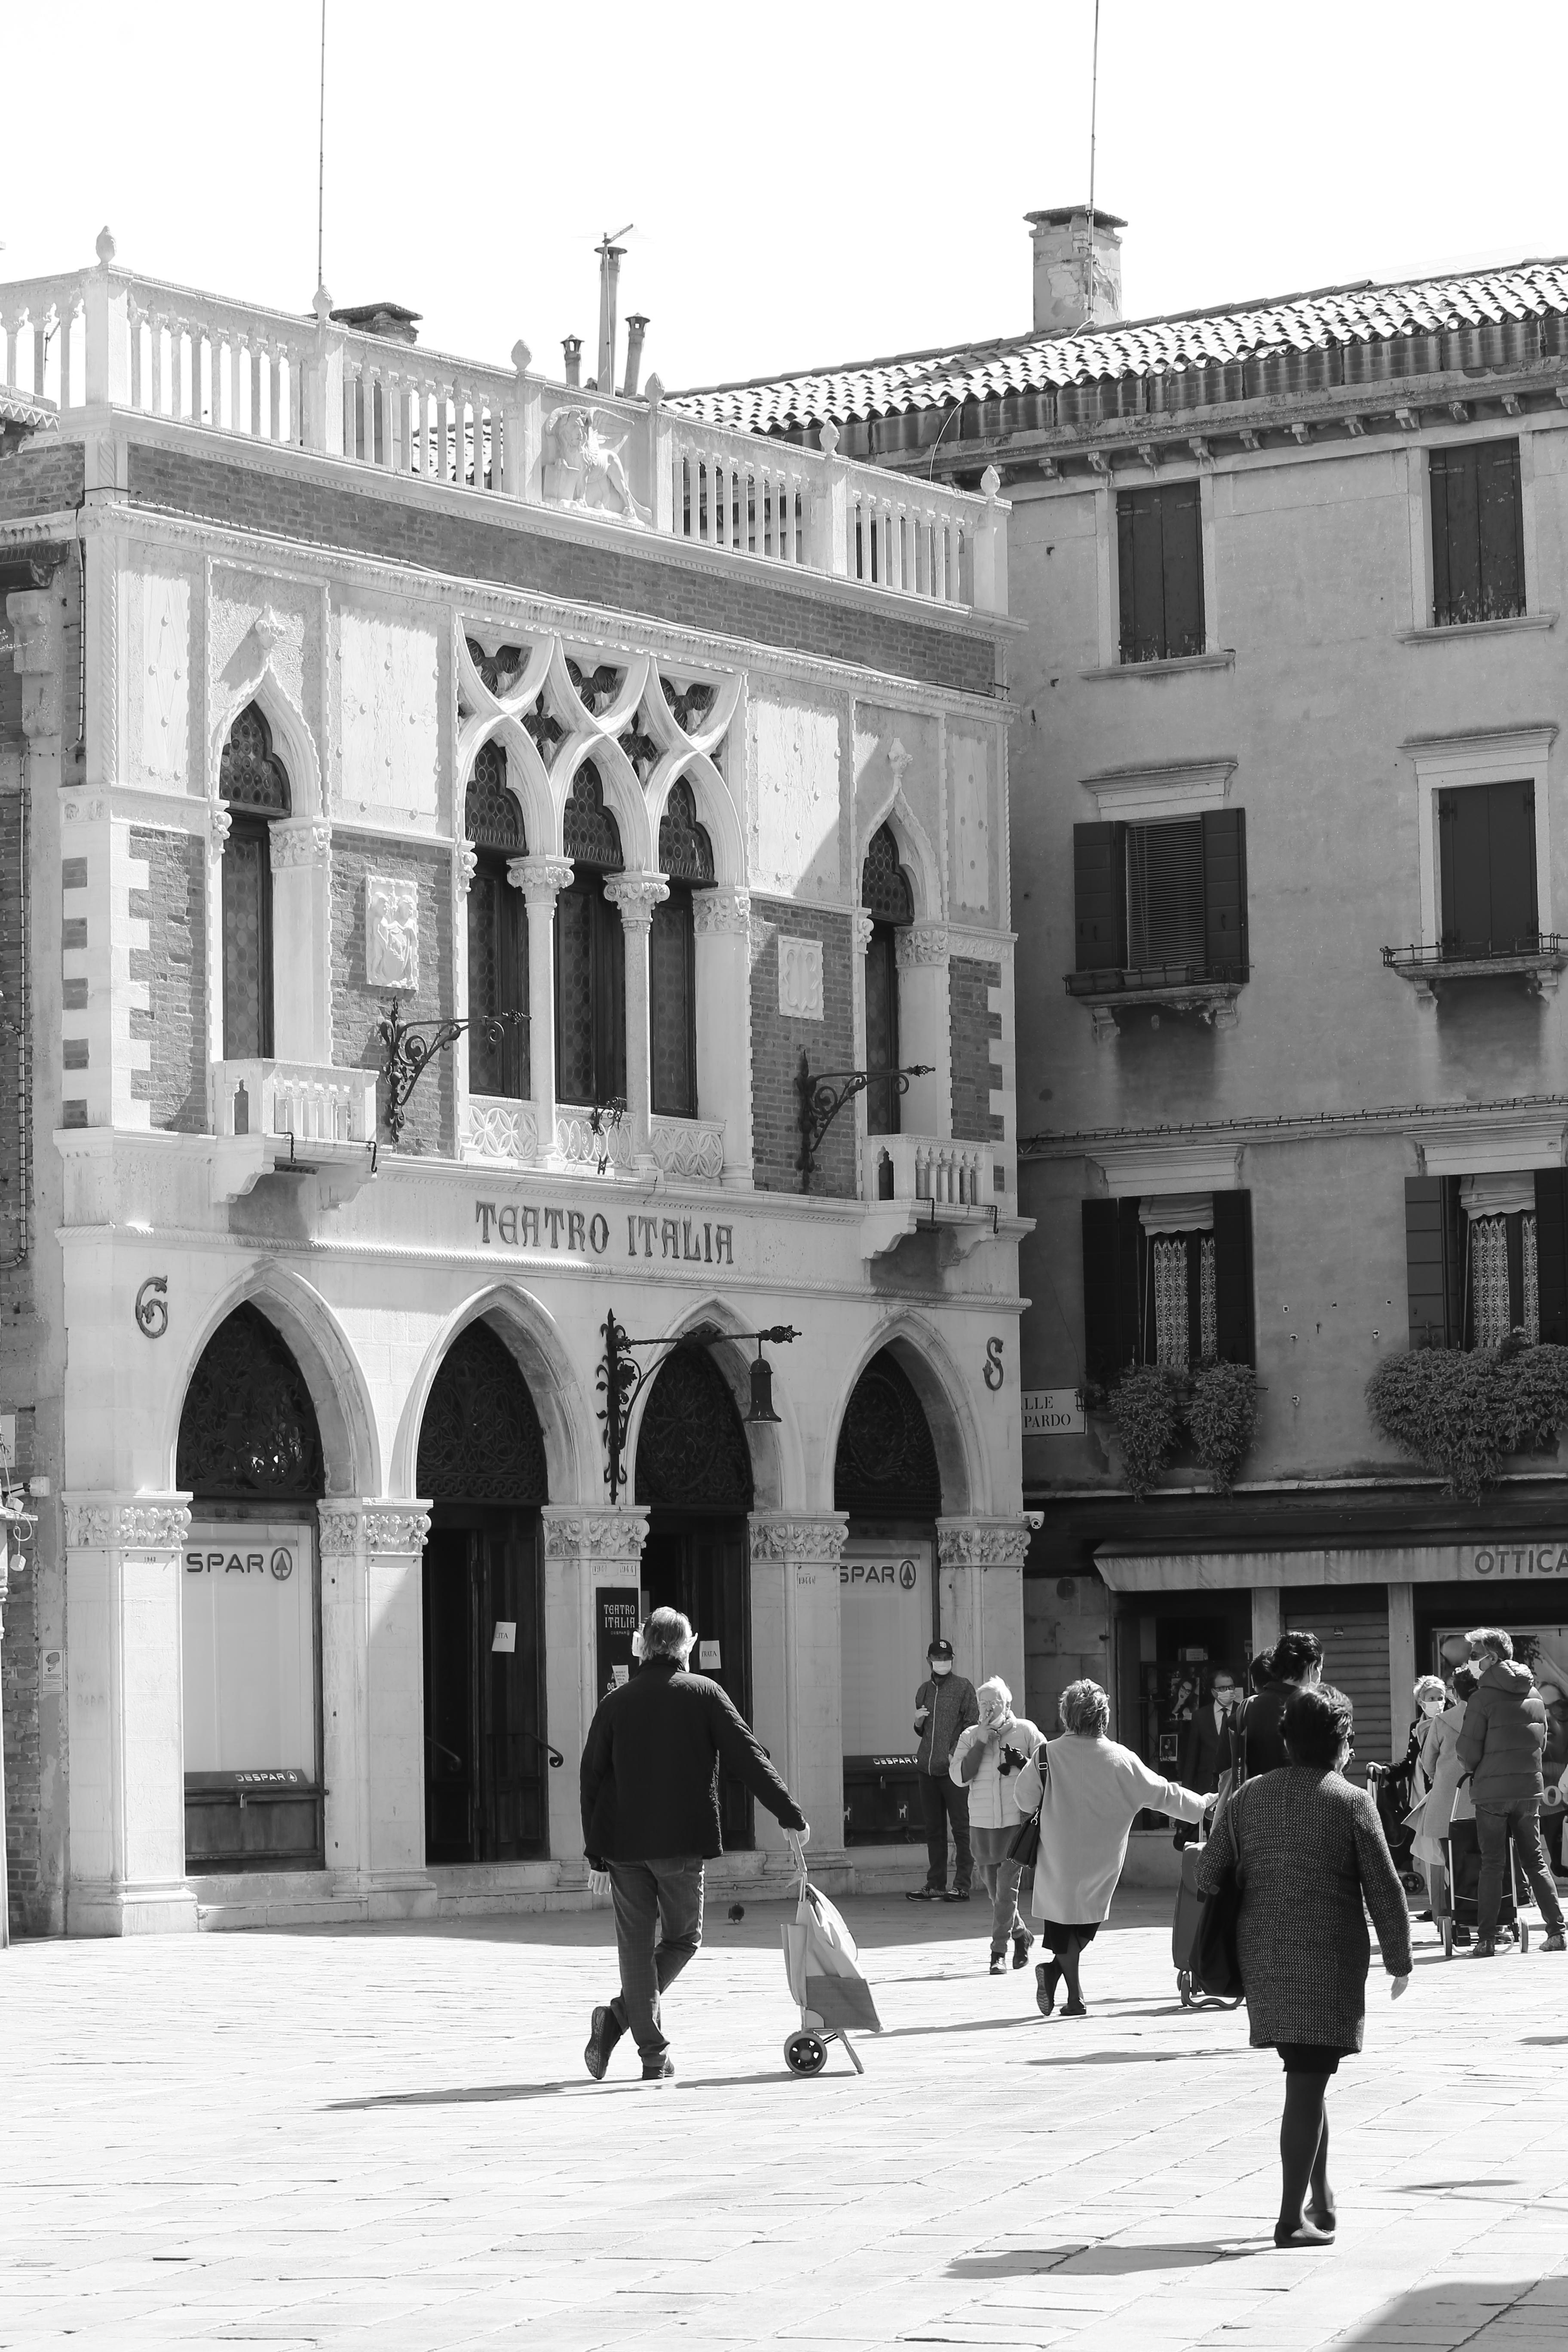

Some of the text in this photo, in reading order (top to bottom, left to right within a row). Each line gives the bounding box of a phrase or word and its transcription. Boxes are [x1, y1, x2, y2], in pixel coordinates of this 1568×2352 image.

[476, 1200, 733, 1264] TEATRO ITALIA
[1021, 1396, 1053, 1410] LLE
[1024, 1414, 1071, 1428] PARDO
[187, 1553, 264, 1573] SPAR
[1475, 1549, 1568, 1574] OTTICA
[840, 1566, 894, 1583] SPAR
[604, 1605, 635, 1615] TEATRO
[605, 1617, 635, 1628] ITALIA
[873, 1757, 912, 1765] DESPAR
[235, 1773, 285, 1782] DESPAR
